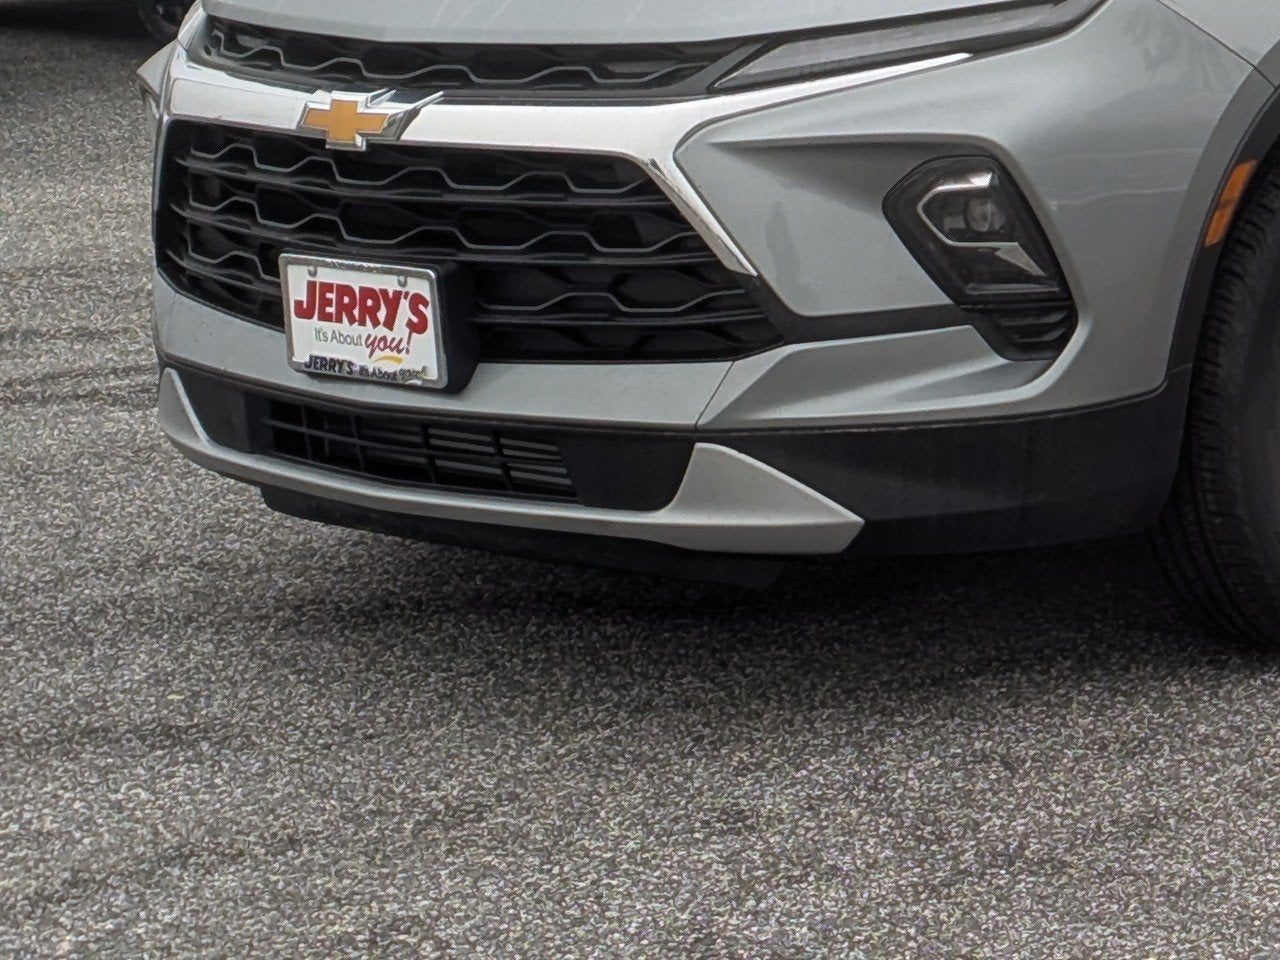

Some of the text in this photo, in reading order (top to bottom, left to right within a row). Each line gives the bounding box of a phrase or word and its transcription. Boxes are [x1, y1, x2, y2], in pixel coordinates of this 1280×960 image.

[294, 280, 429, 335] JERRY'S
[314, 327, 413, 360] It's About you!
